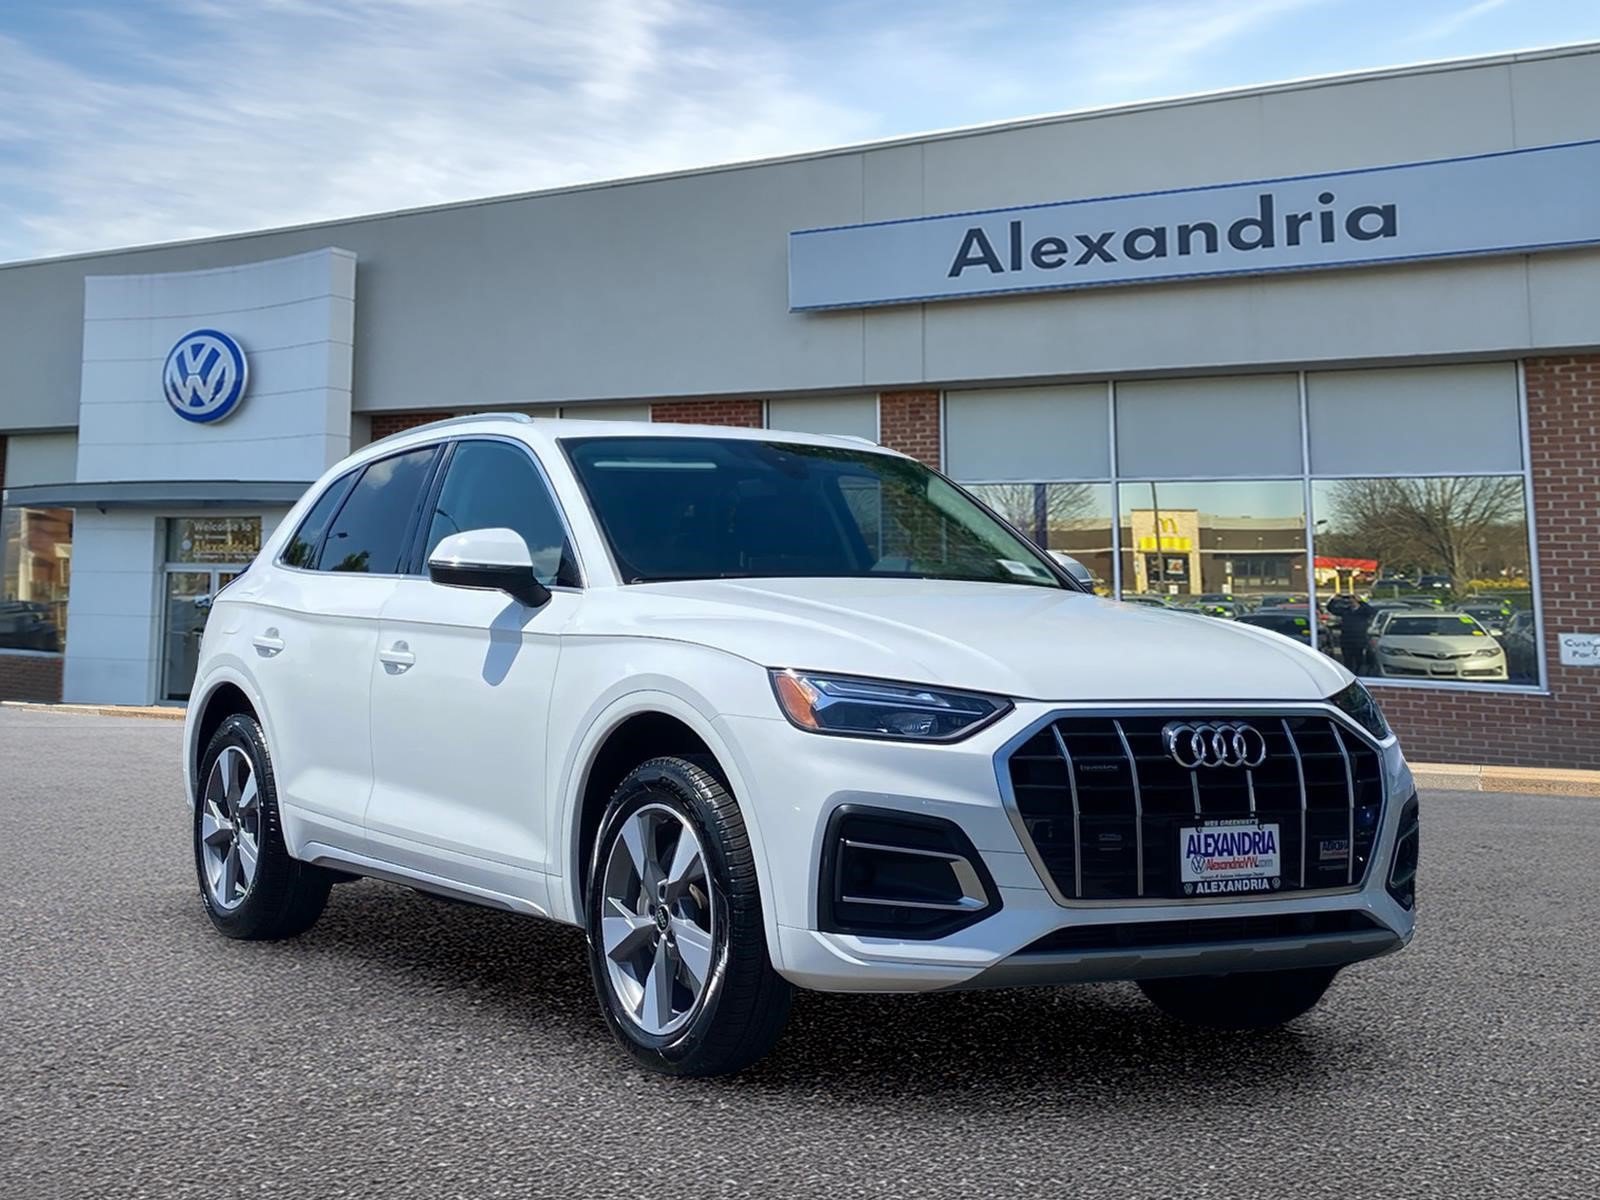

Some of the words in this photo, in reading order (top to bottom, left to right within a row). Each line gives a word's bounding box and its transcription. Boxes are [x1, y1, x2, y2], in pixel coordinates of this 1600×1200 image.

[948, 192, 1398, 278] Alexandria
[1186, 830, 1277, 859] ALEXANDRIA
[1196, 878, 1270, 894] ALEXANDRIA
